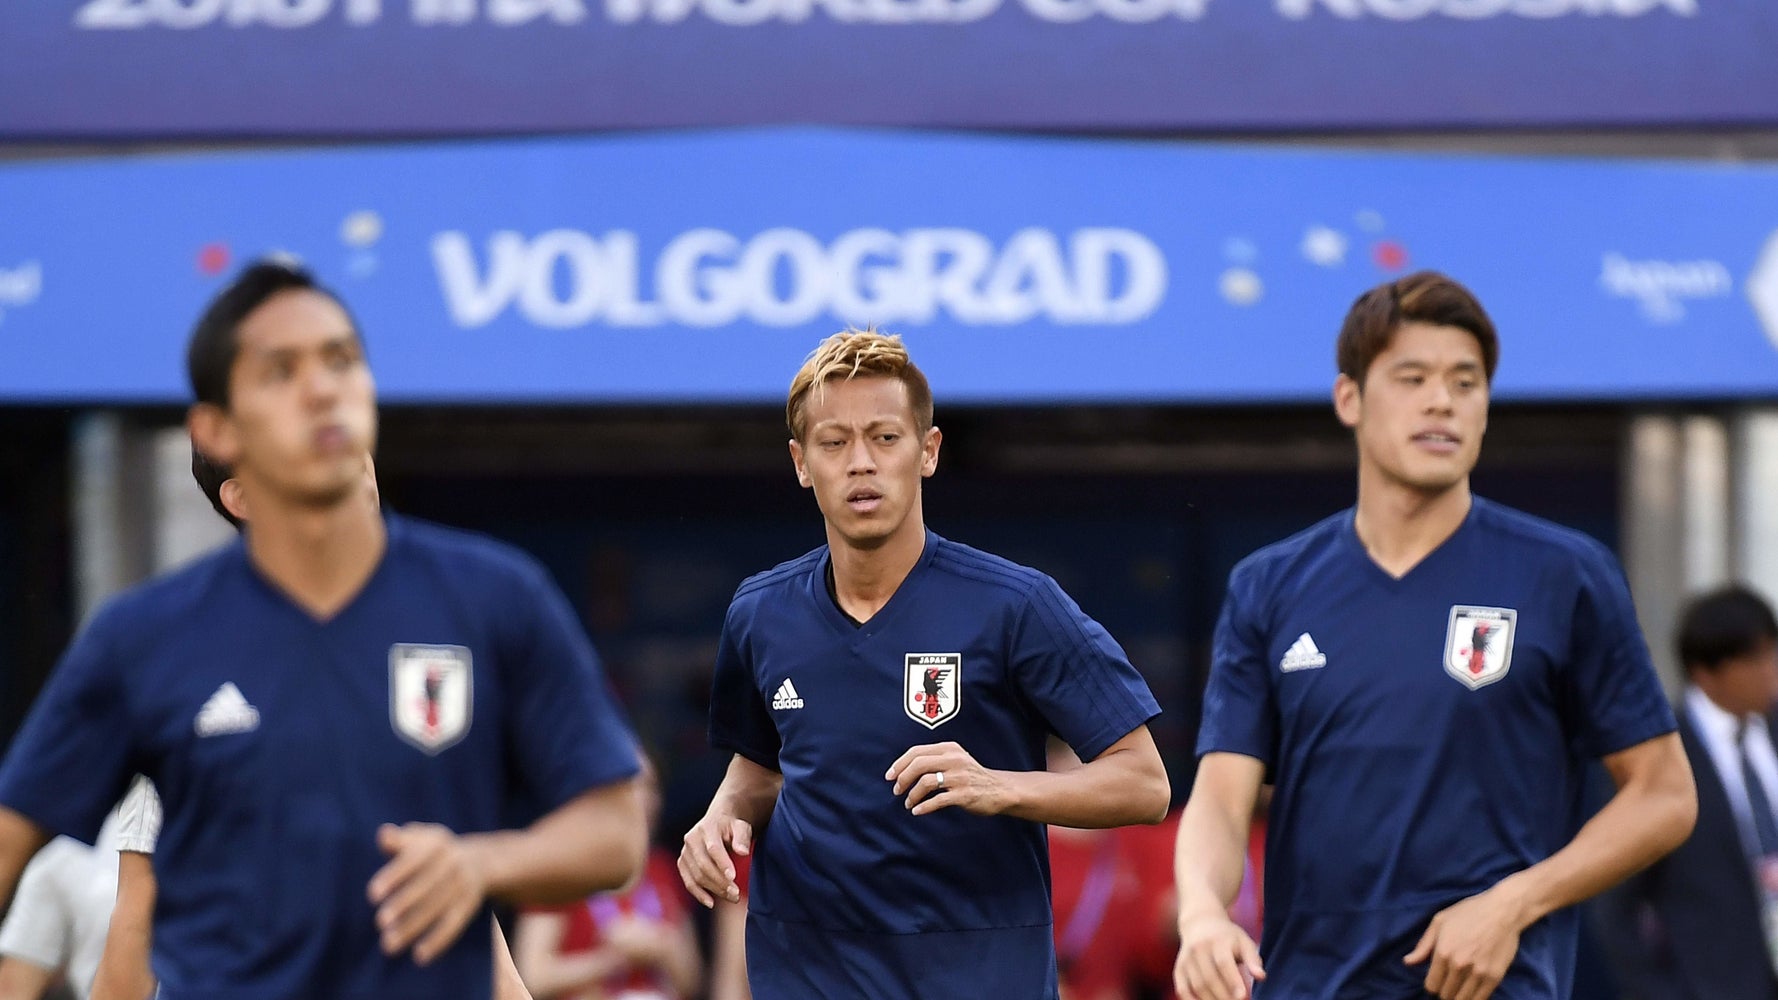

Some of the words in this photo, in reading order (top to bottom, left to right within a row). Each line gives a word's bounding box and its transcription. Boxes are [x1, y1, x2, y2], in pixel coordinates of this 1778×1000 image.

[431, 227, 1168, 328] VOLGOGRAD
[919, 656, 947, 664] JAPAN
[772, 697, 804, 710] adidas
[920, 704, 943, 713] JFA
